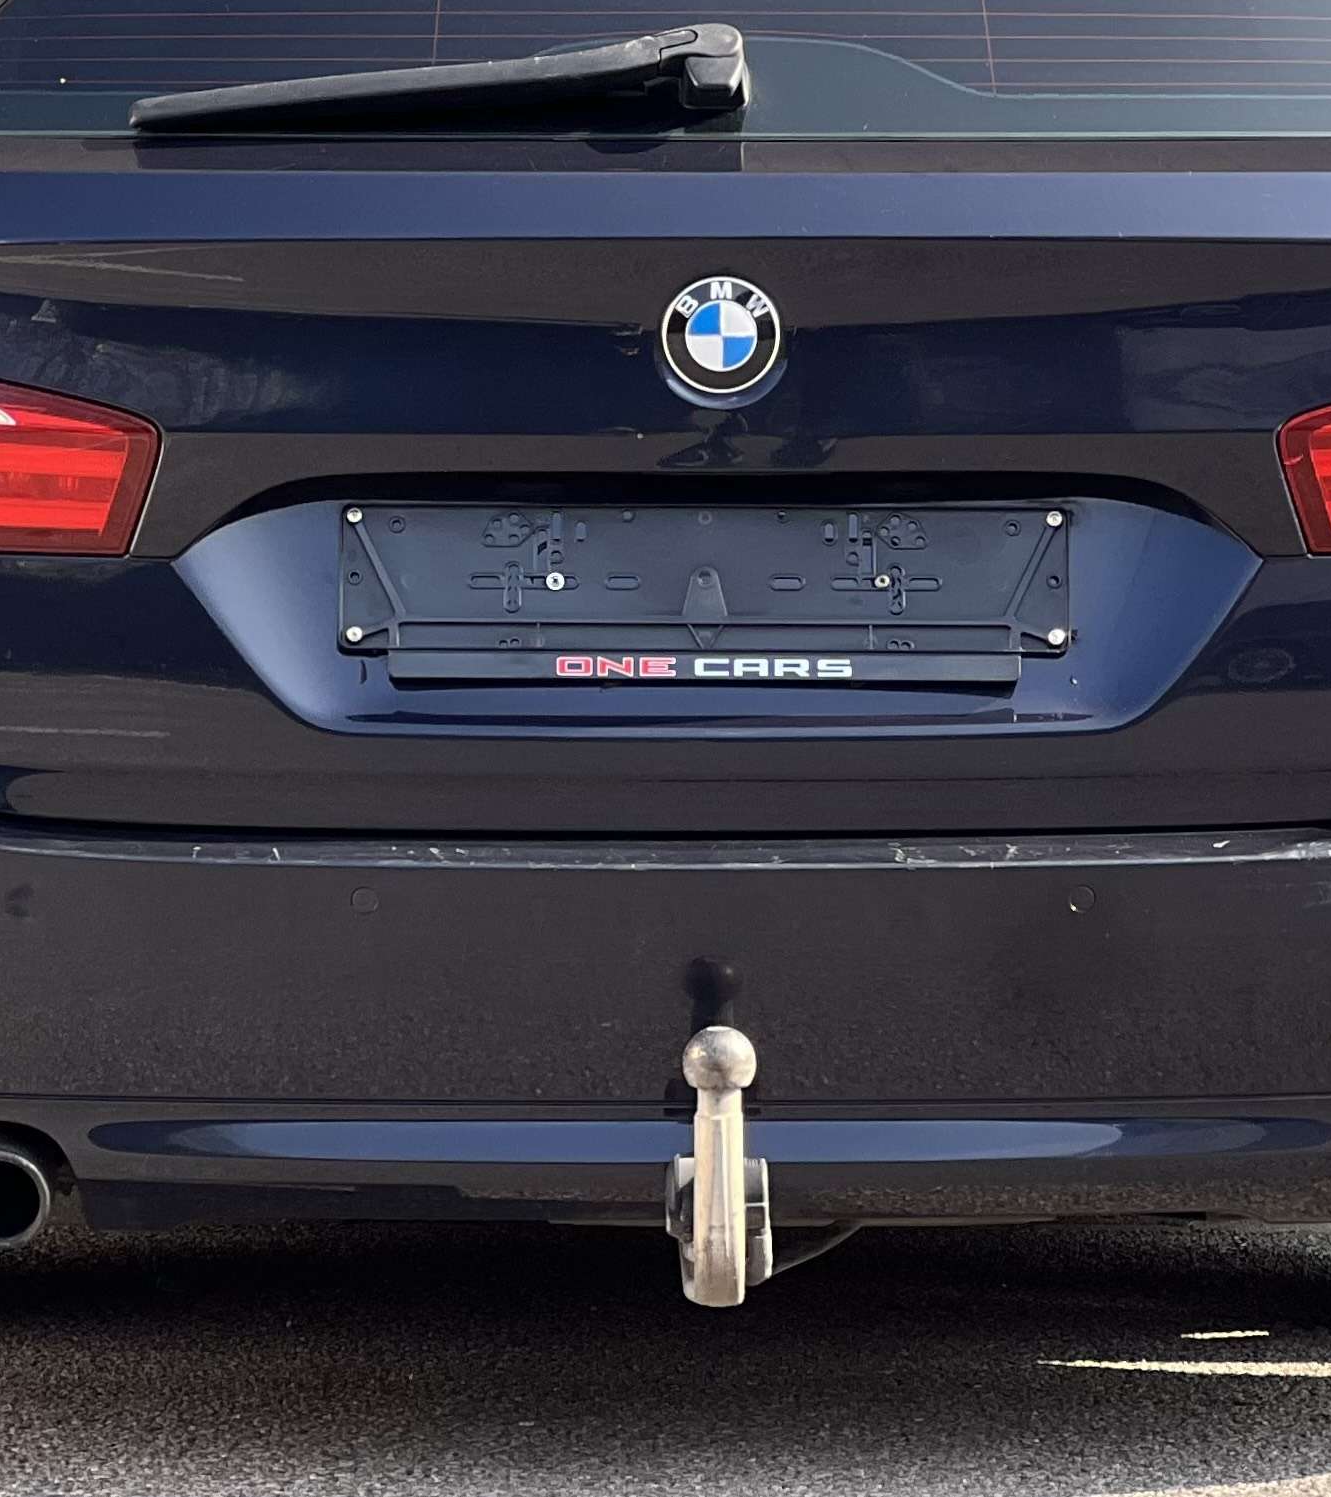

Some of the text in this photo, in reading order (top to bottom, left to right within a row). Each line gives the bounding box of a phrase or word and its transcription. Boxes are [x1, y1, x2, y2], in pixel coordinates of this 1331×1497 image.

[674, 280, 771, 319] BMW
[556, 655, 853, 678] ONE CARS
